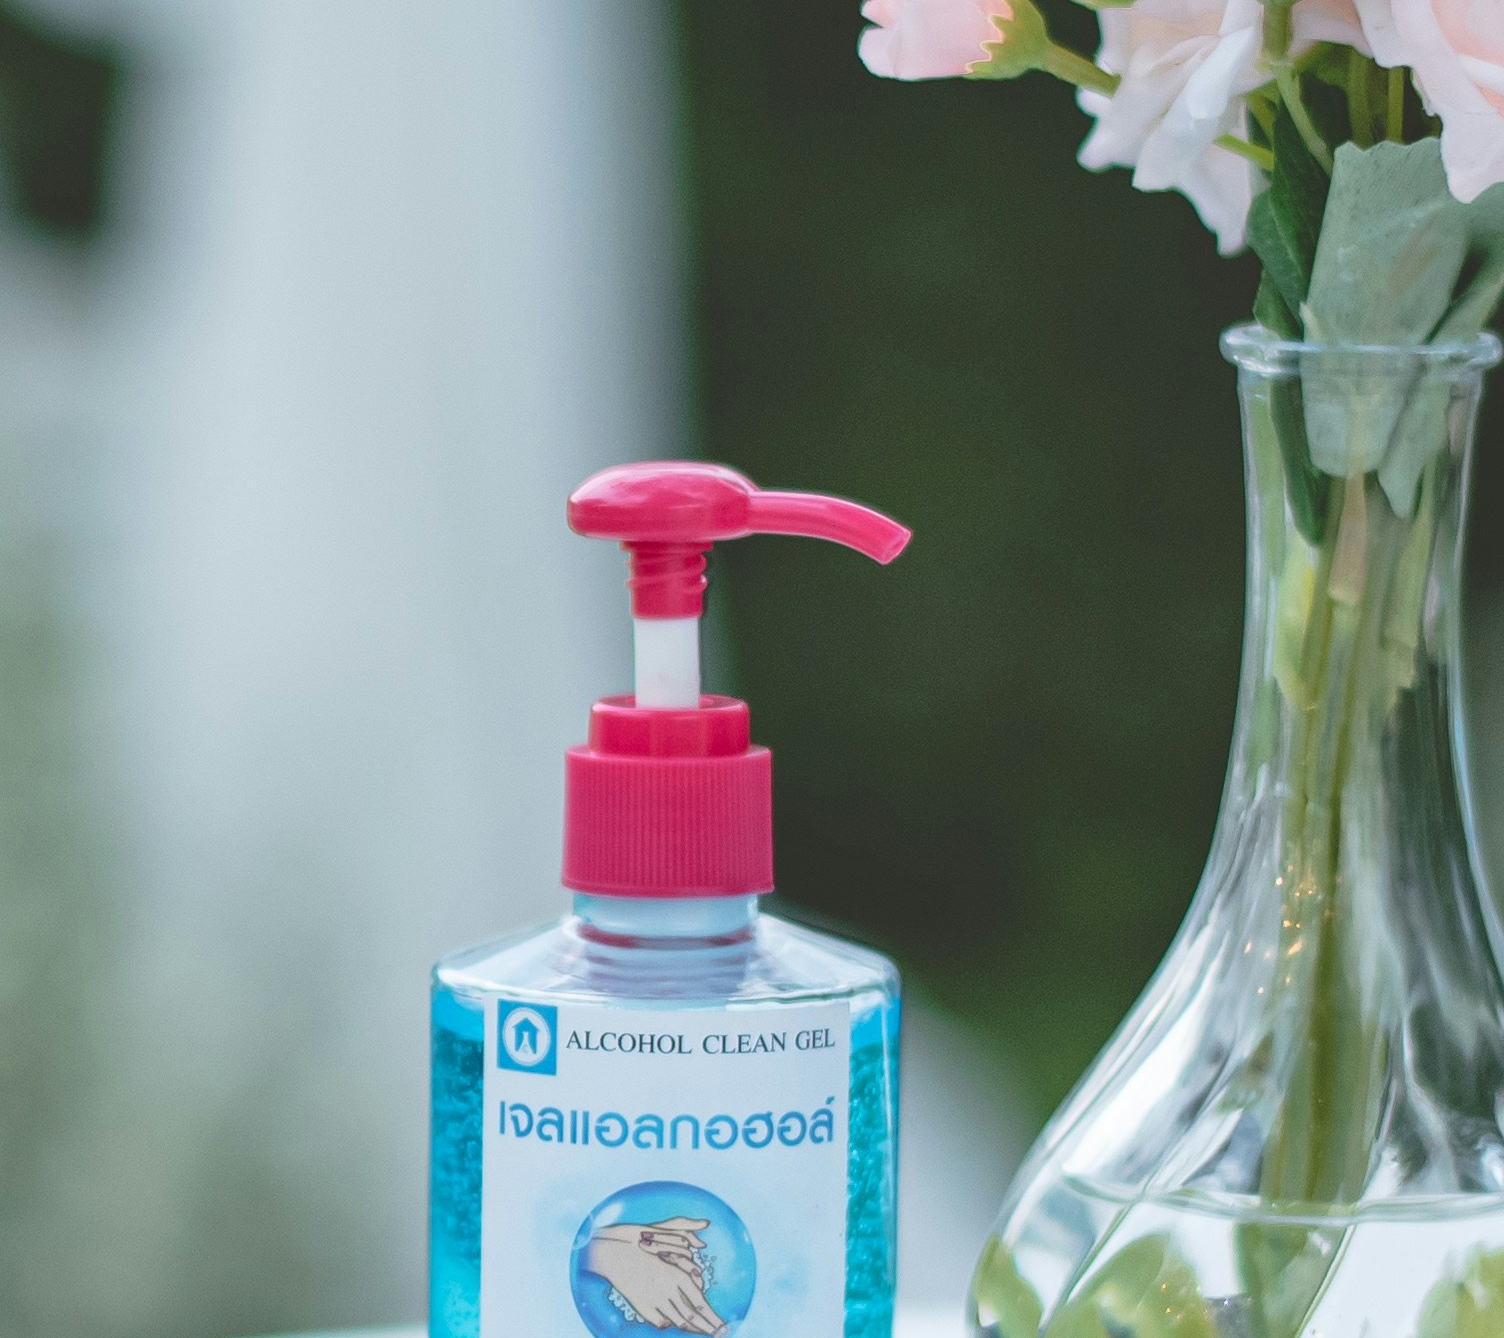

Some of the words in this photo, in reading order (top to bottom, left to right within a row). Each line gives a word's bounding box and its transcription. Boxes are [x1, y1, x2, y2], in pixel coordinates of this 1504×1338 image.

[566, 1030, 693, 1054] ALCOHOL
[702, 1032, 787, 1055] CLEAN
[795, 1028, 836, 1050] GEL
[499, 1095, 836, 1150] เจลแอลกอฮอล์
